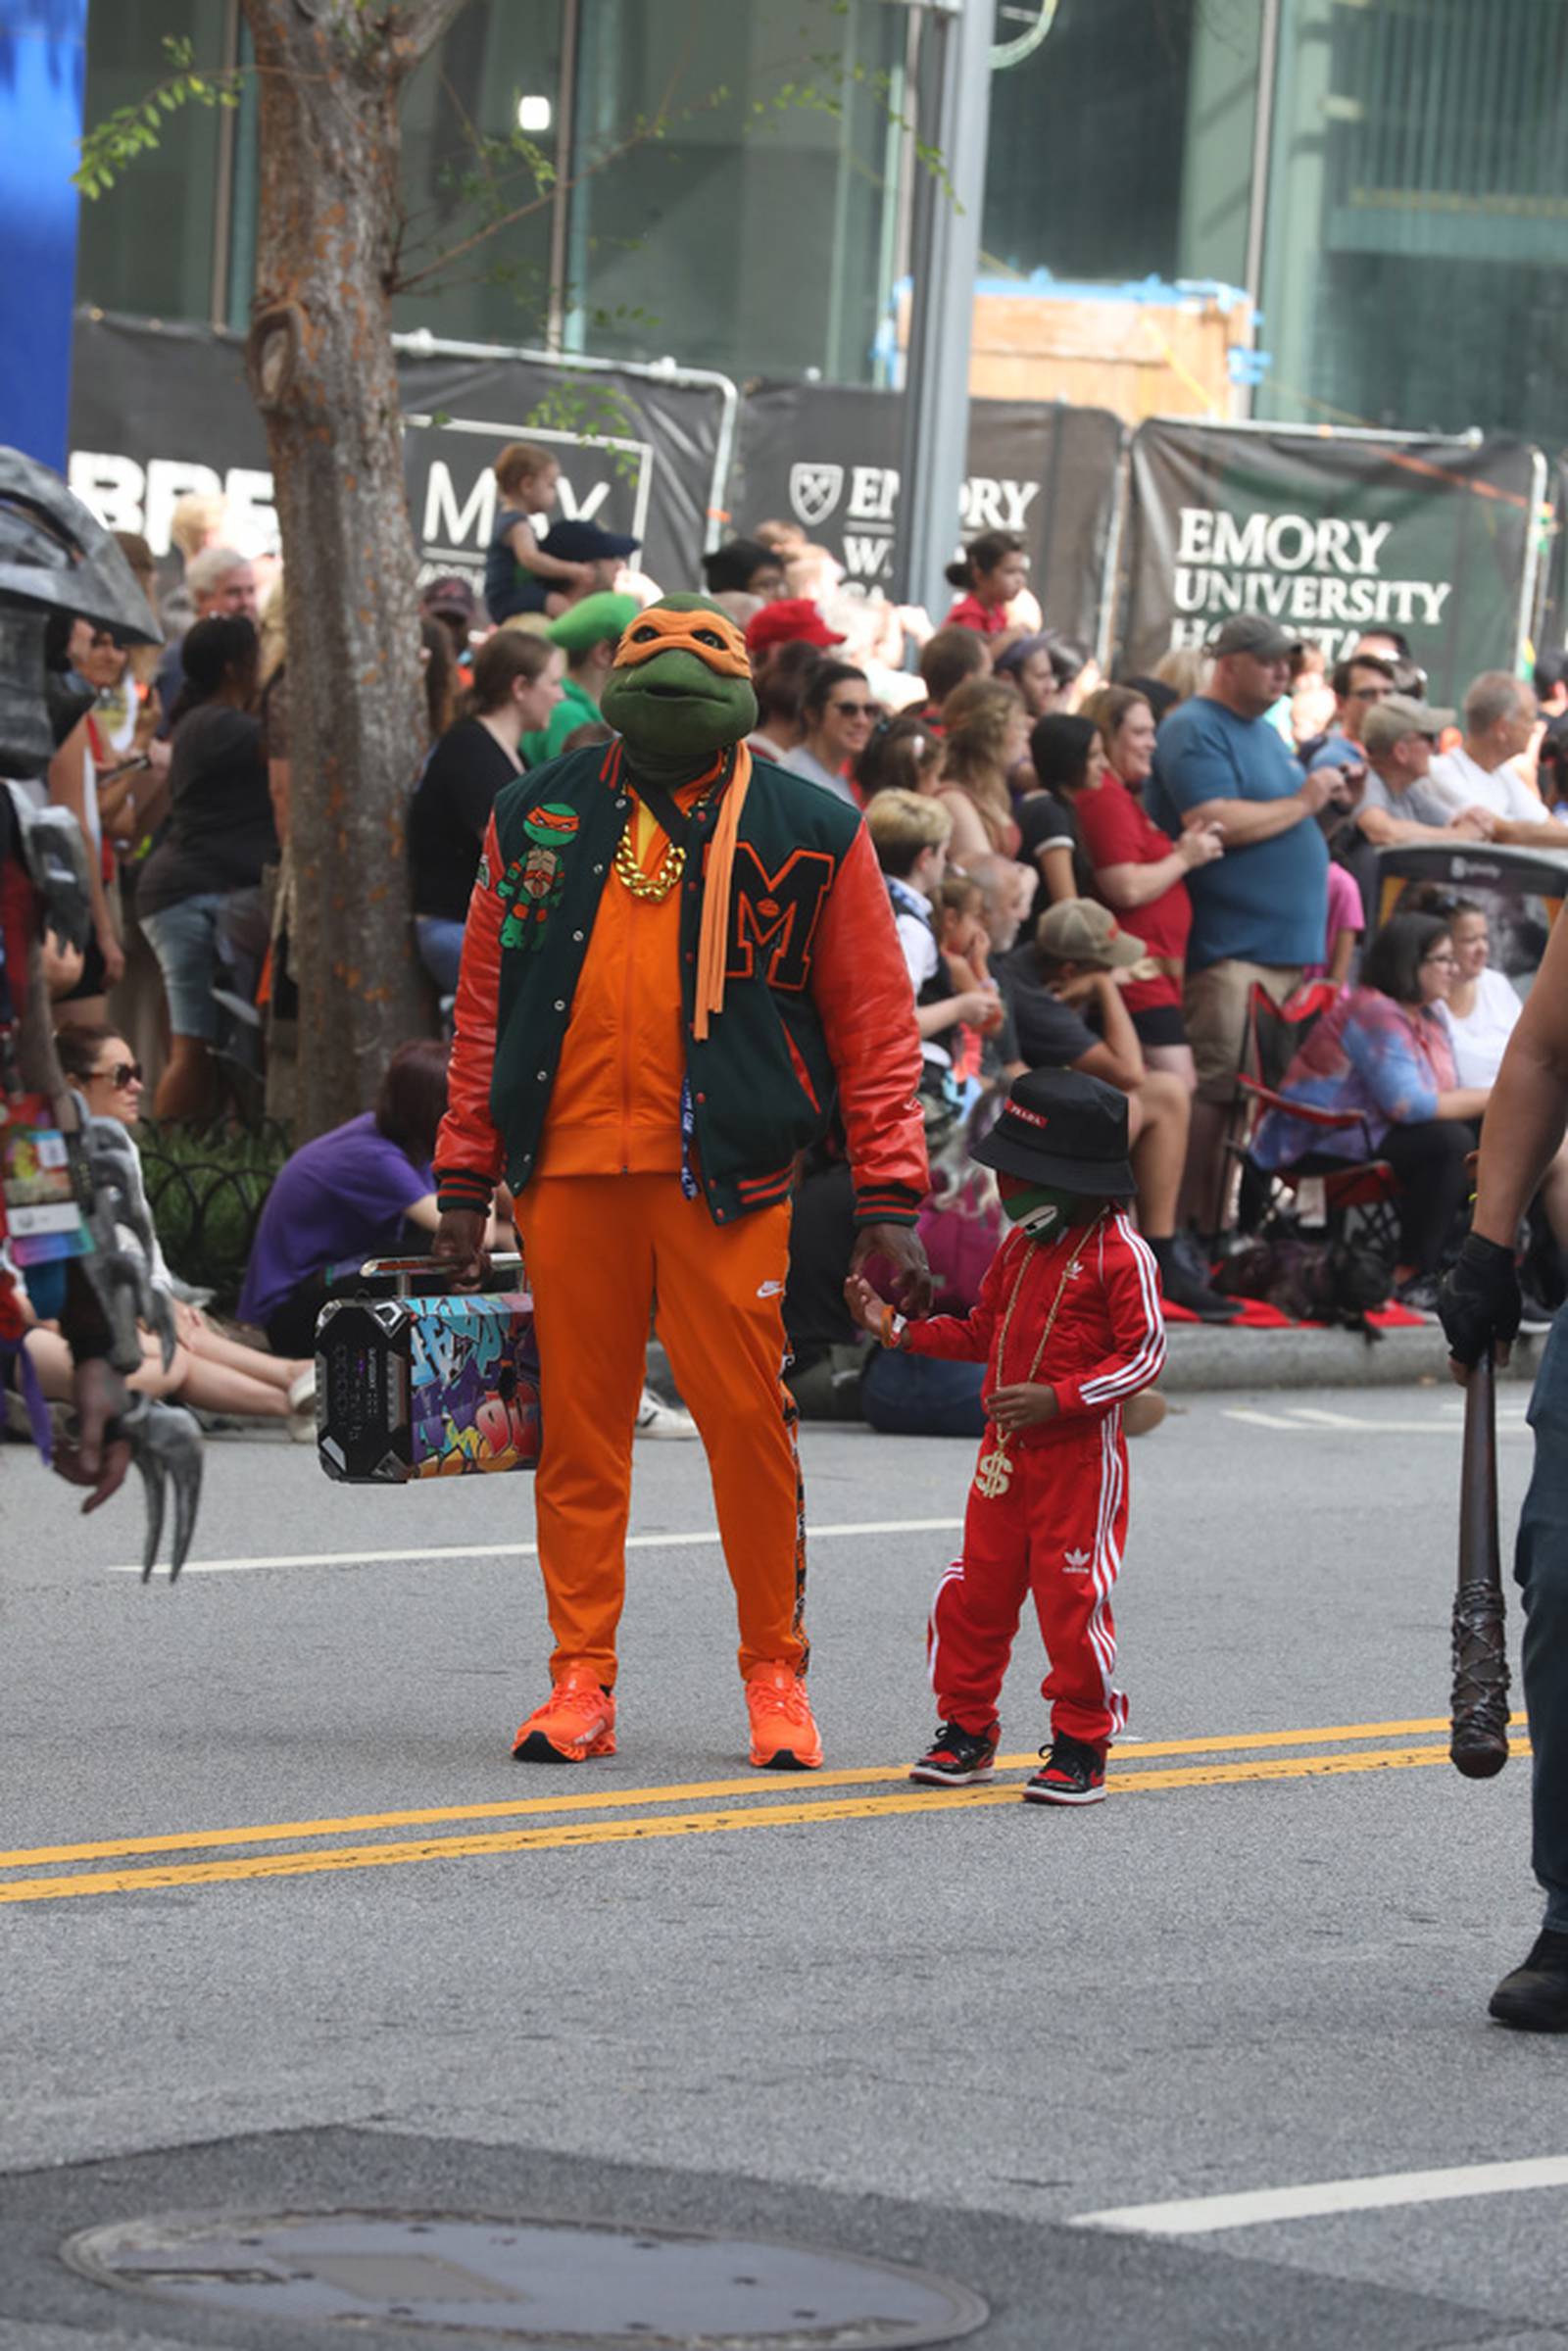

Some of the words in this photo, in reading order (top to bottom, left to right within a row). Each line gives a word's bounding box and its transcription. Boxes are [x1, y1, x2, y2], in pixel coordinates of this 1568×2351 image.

[1177, 507, 1394, 575] EMORY
[1174, 566, 1452, 625] UNIVERSITY
[702, 841, 836, 991] M
